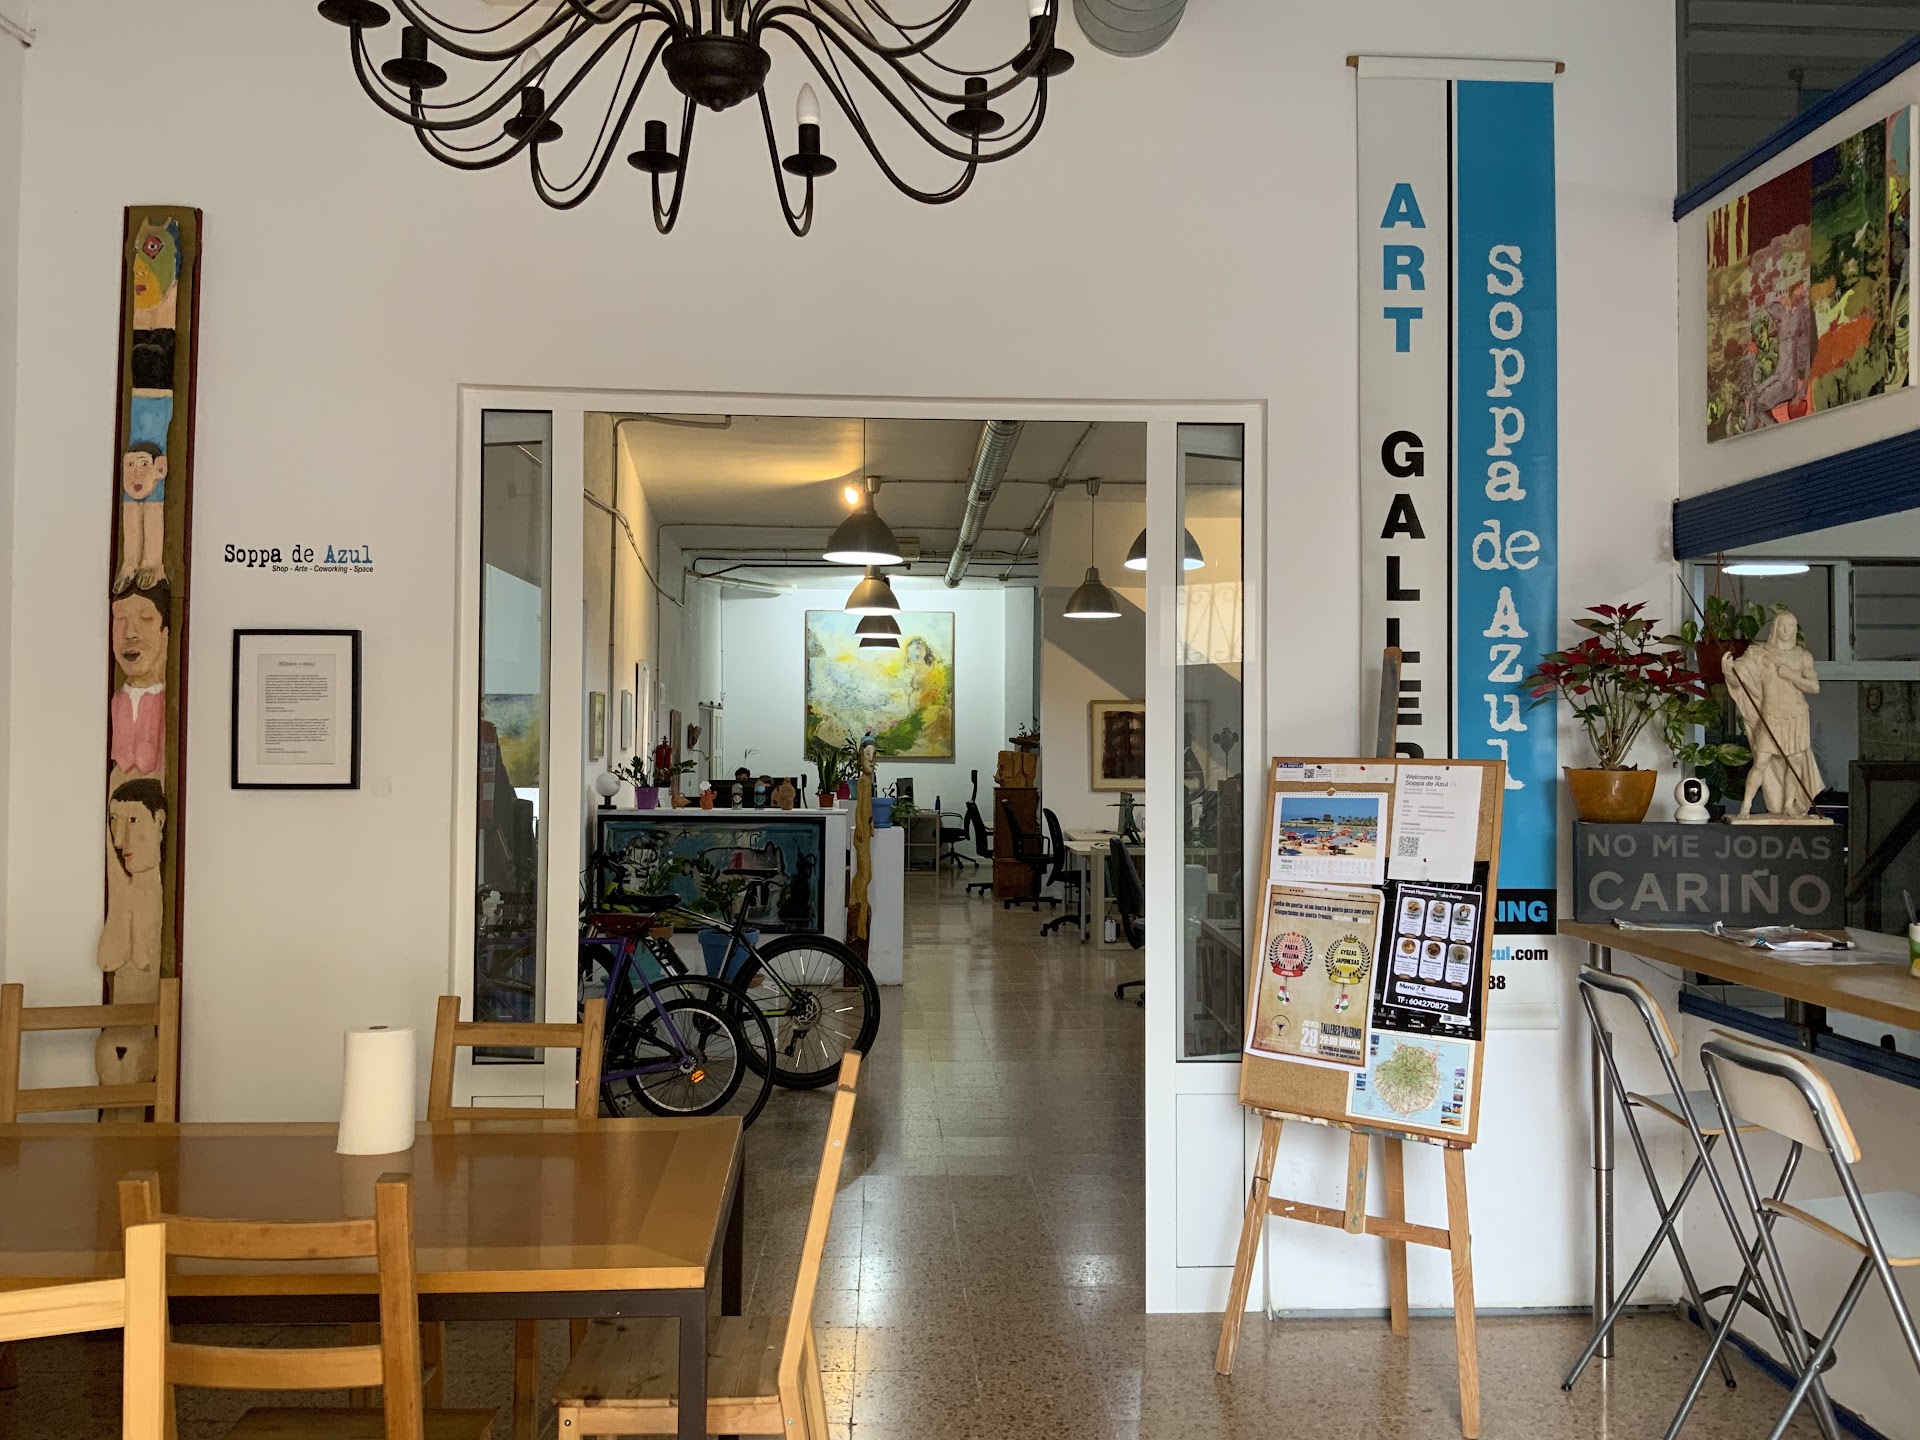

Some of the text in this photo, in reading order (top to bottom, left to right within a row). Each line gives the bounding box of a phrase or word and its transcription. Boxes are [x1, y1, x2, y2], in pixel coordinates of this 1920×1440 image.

[1380, 183, 1426, 352] ART
[1472, 519, 1540, 571] de
[225, 544, 373, 567] Soppa de Azul
[272, 565, 288, 573] Shop
[314, 565, 348, 573] Coworking
[1587, 834, 1831, 860] NO ME JODAS
[1588, 868, 1831, 916] CARIÑO
[1335, 957, 1360, 966] JAPONESAS
[1399, 982, 1415, 991] Menú
[1409, 998, 1449, 1011] 604270872
[1300, 1027, 1318, 1047] 29
[1320, 1035, 1361, 1049] 20:00 HORAS
